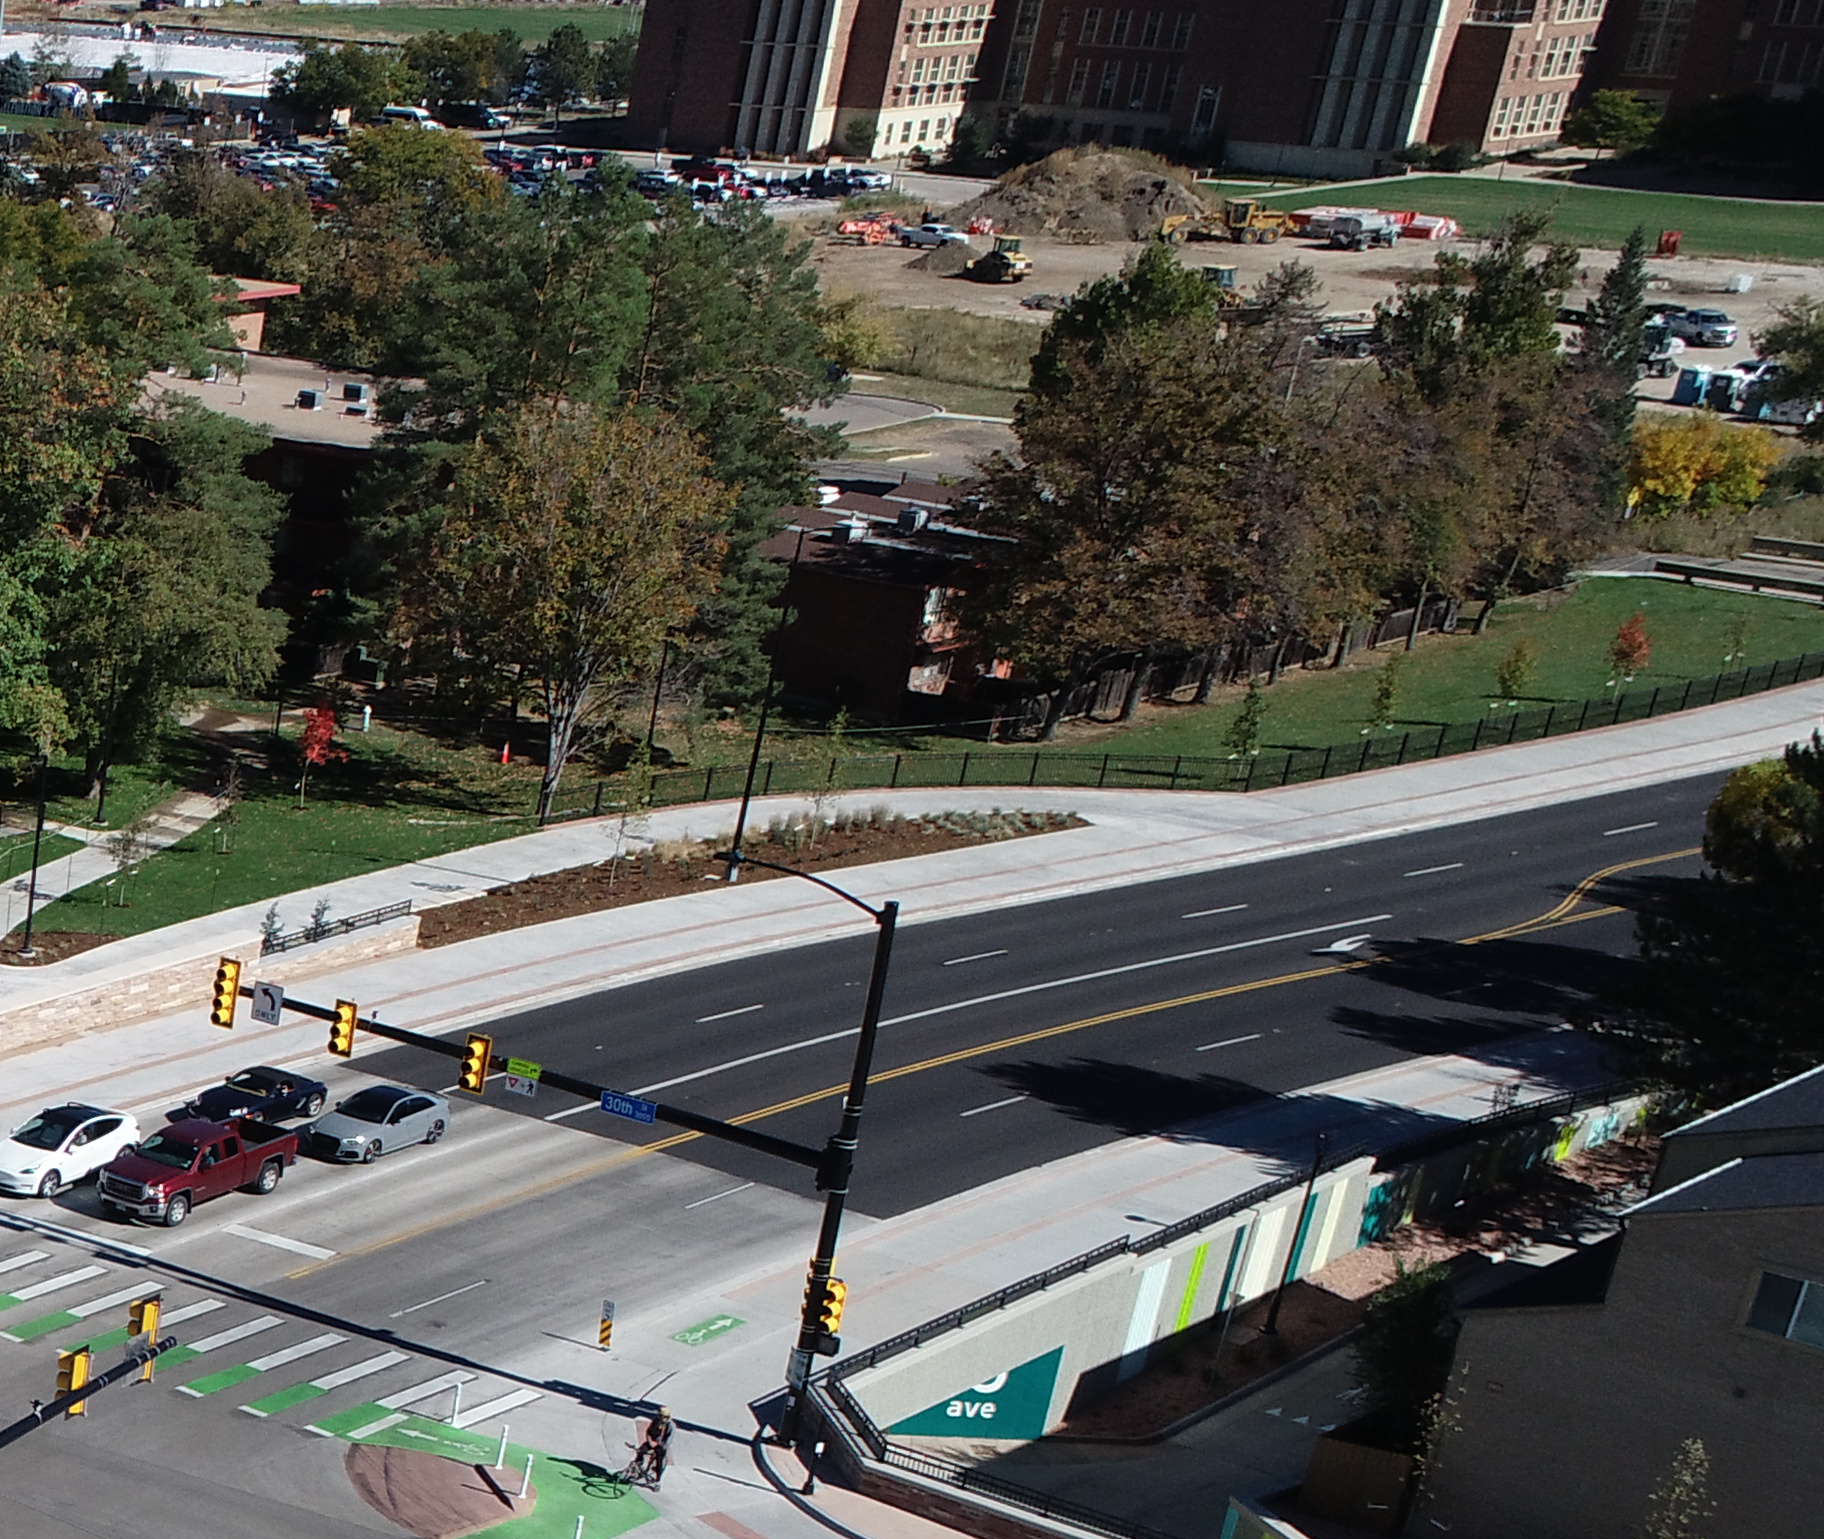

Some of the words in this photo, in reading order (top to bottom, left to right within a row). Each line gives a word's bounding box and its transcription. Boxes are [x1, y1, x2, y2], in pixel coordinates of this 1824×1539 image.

[255, 1009, 275, 1020] ONLY
[605, 1096, 633, 1115] 30th
[946, 1399, 997, 1419] ave
